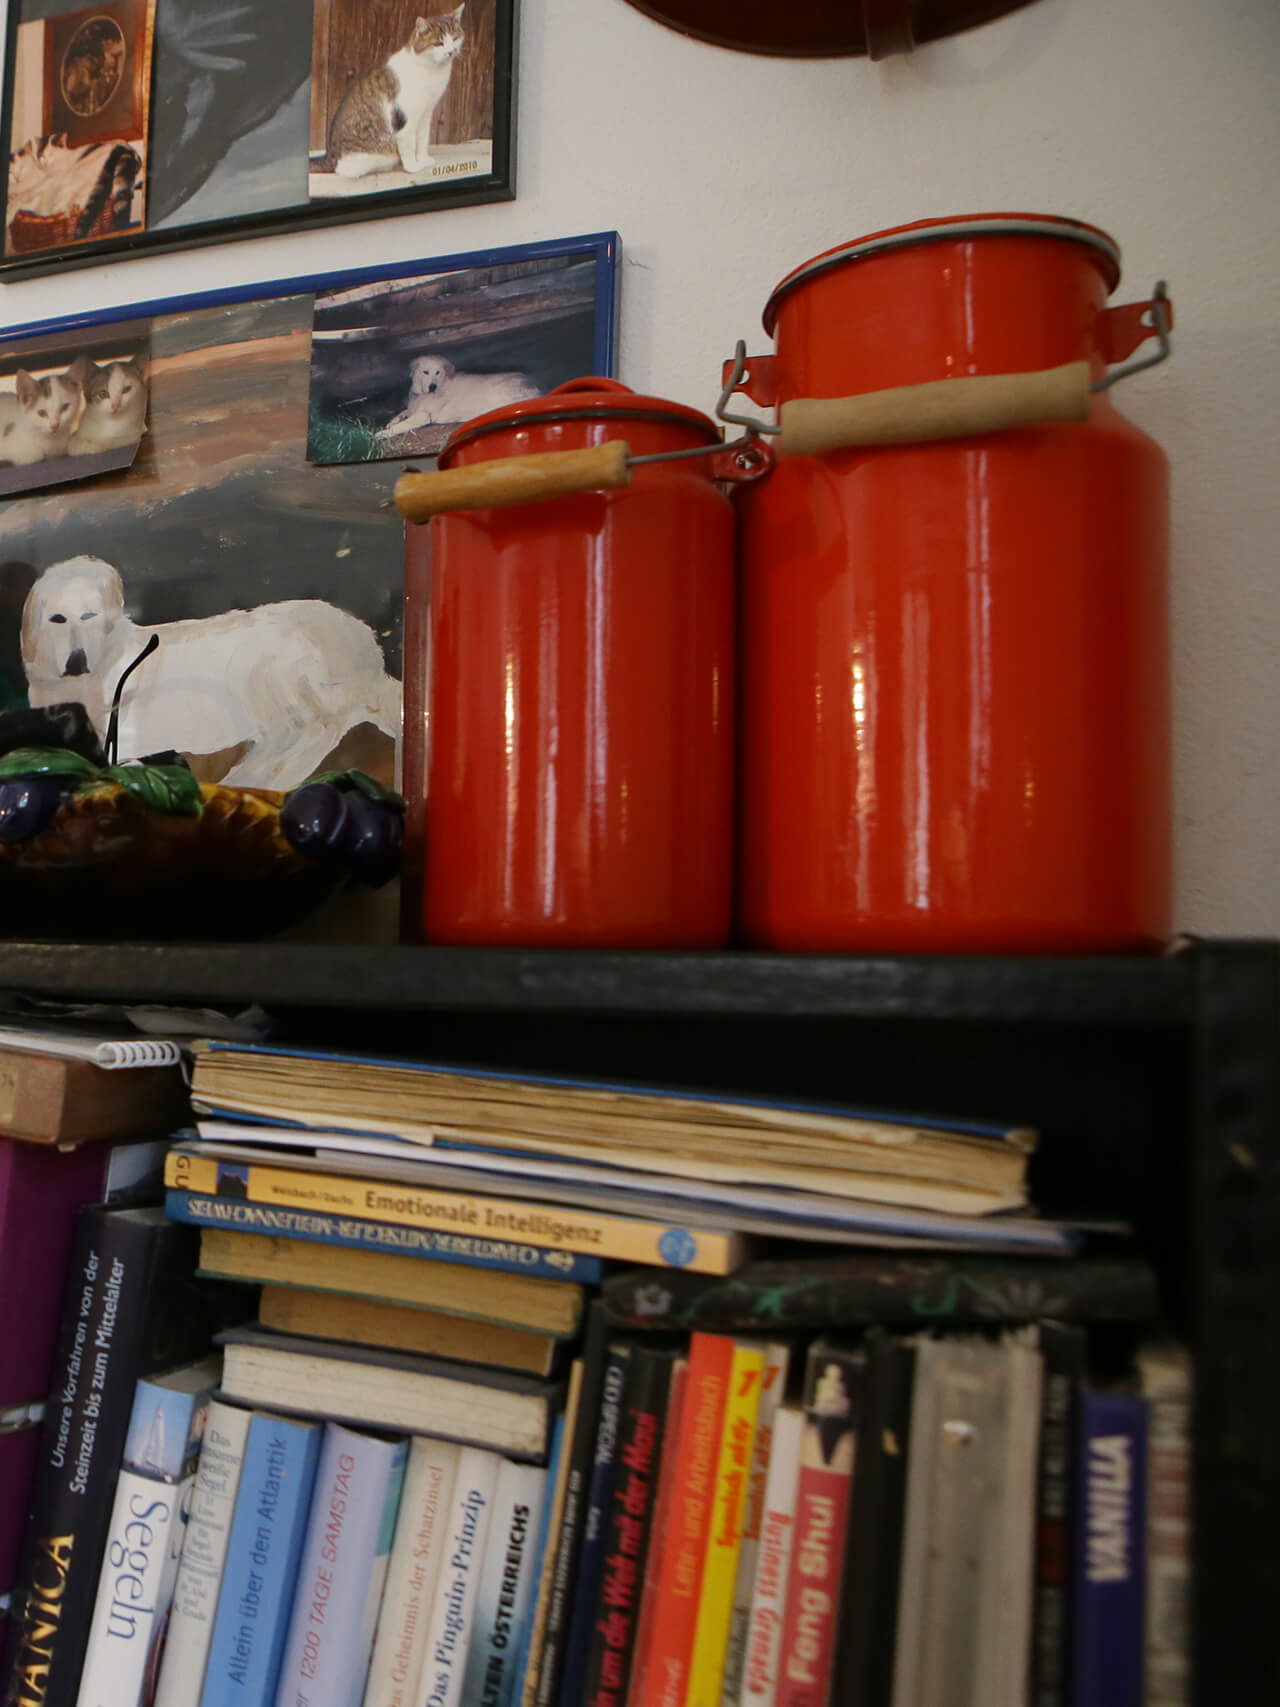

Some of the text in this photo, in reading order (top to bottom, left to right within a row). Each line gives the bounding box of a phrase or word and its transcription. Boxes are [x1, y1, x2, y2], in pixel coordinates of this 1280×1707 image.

[365, 1189, 603, 1244] Emotionale Intelligenz
[51, 1250, 99, 1468] Unsere Vorfahren von der
[70, 1257, 125, 1494] Steinzeit bis zum Mittelalter
[321, 1453, 356, 1564] SAMSTAG
[414, 1465, 443, 1560] Schatzinsel
[614, 1515, 642, 1553] mit
[616, 1473, 650, 1515] der
[107, 1494, 169, 1639] Segeln
[228, 1437, 288, 1686] Allein über den Atlantik
[309, 1568, 334, 1626] TAGE
[408, 1565, 426, 1592] der
[435, 1489, 487, 1668] Pinguin-Prinzip
[488, 1504, 531, 1651] ÖSTERREICHS
[603, 1555, 637, 1608] Welt
[300, 1631, 321, 1681] 1200
[392, 1597, 419, 1684] Geheimnis
[596, 1612, 630, 1649] die
[787, 1588, 828, 1686] Feng
